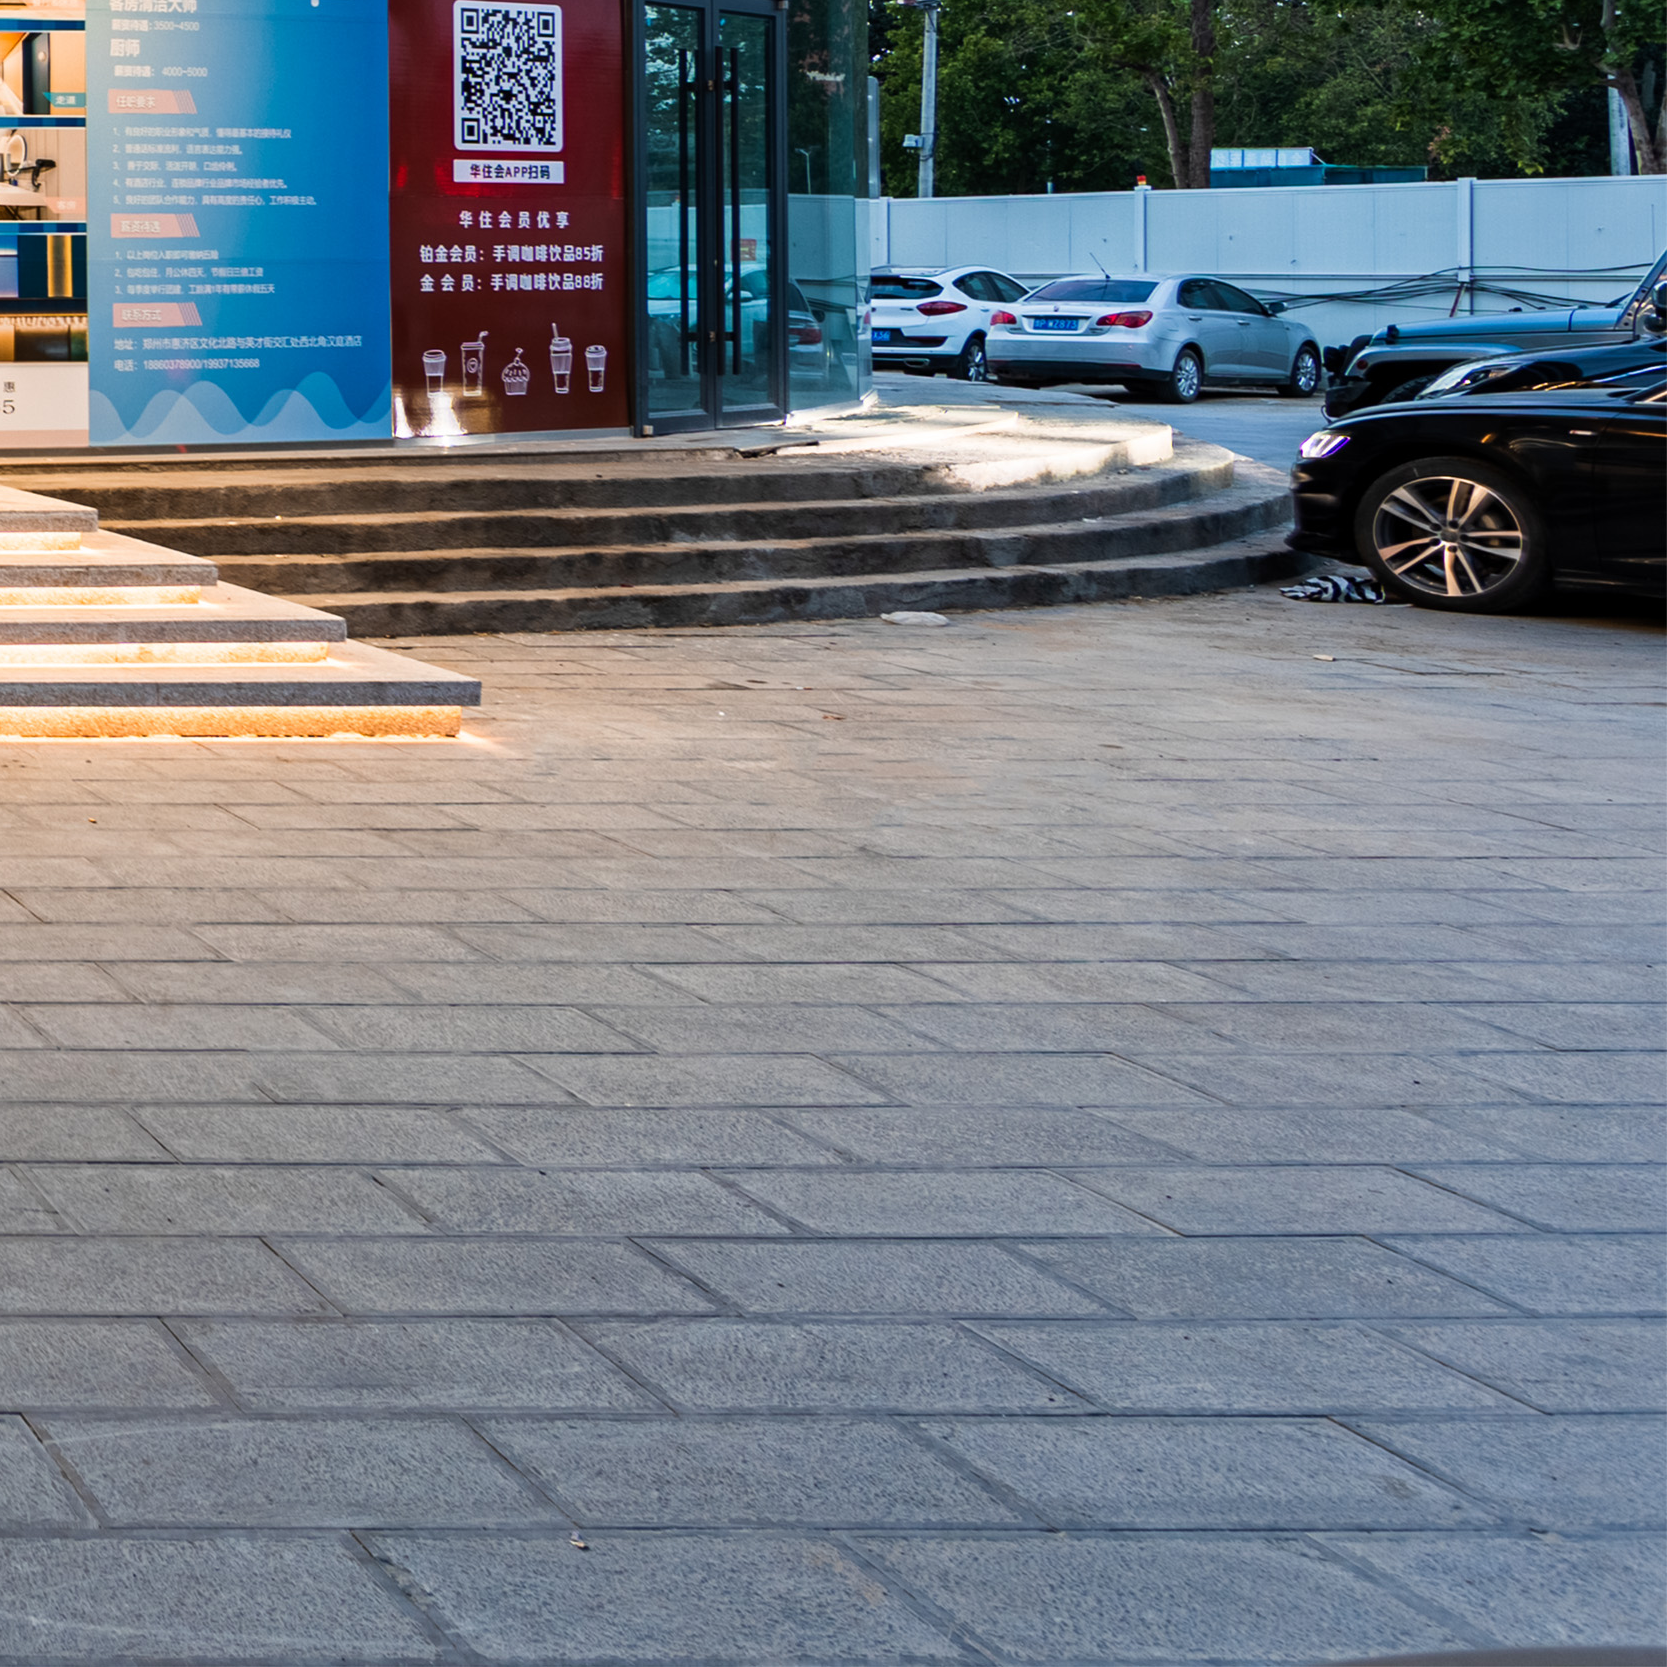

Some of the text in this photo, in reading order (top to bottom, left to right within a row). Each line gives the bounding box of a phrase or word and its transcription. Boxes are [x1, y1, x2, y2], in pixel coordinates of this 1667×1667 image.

[110, 38, 140, 57] 厨师
[470, 164, 551, 180] 华住会APP扫码
[459, 210, 570, 229] 华住会员优享
